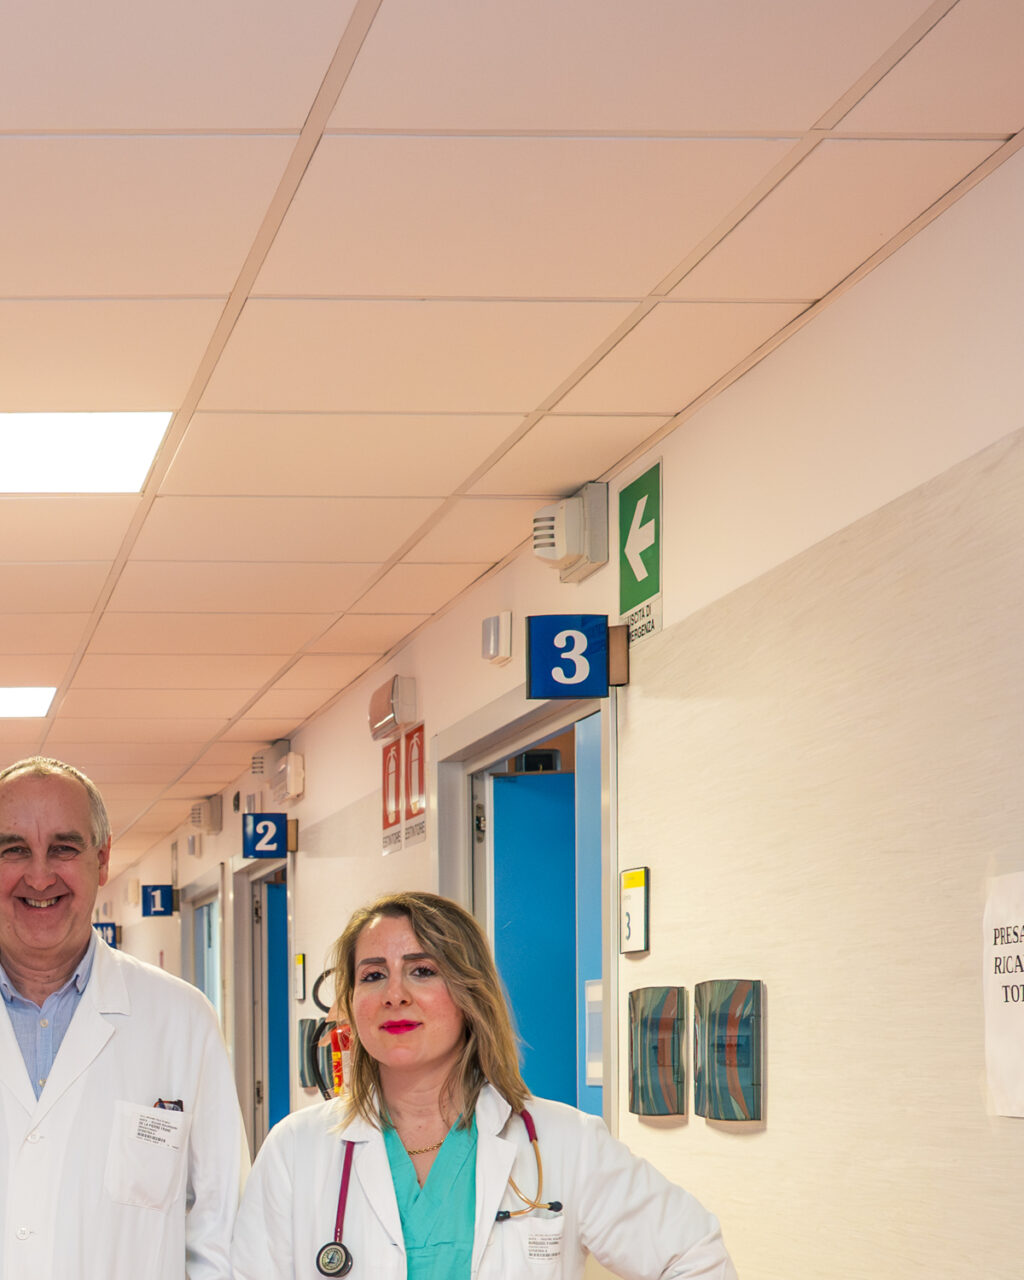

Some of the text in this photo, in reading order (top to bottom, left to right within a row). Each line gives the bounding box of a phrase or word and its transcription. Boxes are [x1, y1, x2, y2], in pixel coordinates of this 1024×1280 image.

[629, 618, 655, 642] ERGENZA
[551, 629, 590, 685] 3
[255, 820, 278, 851] 2
[151, 889, 165, 912] 1
[625, 911, 631, 941] 3
[994, 954, 1024, 974] RICA
